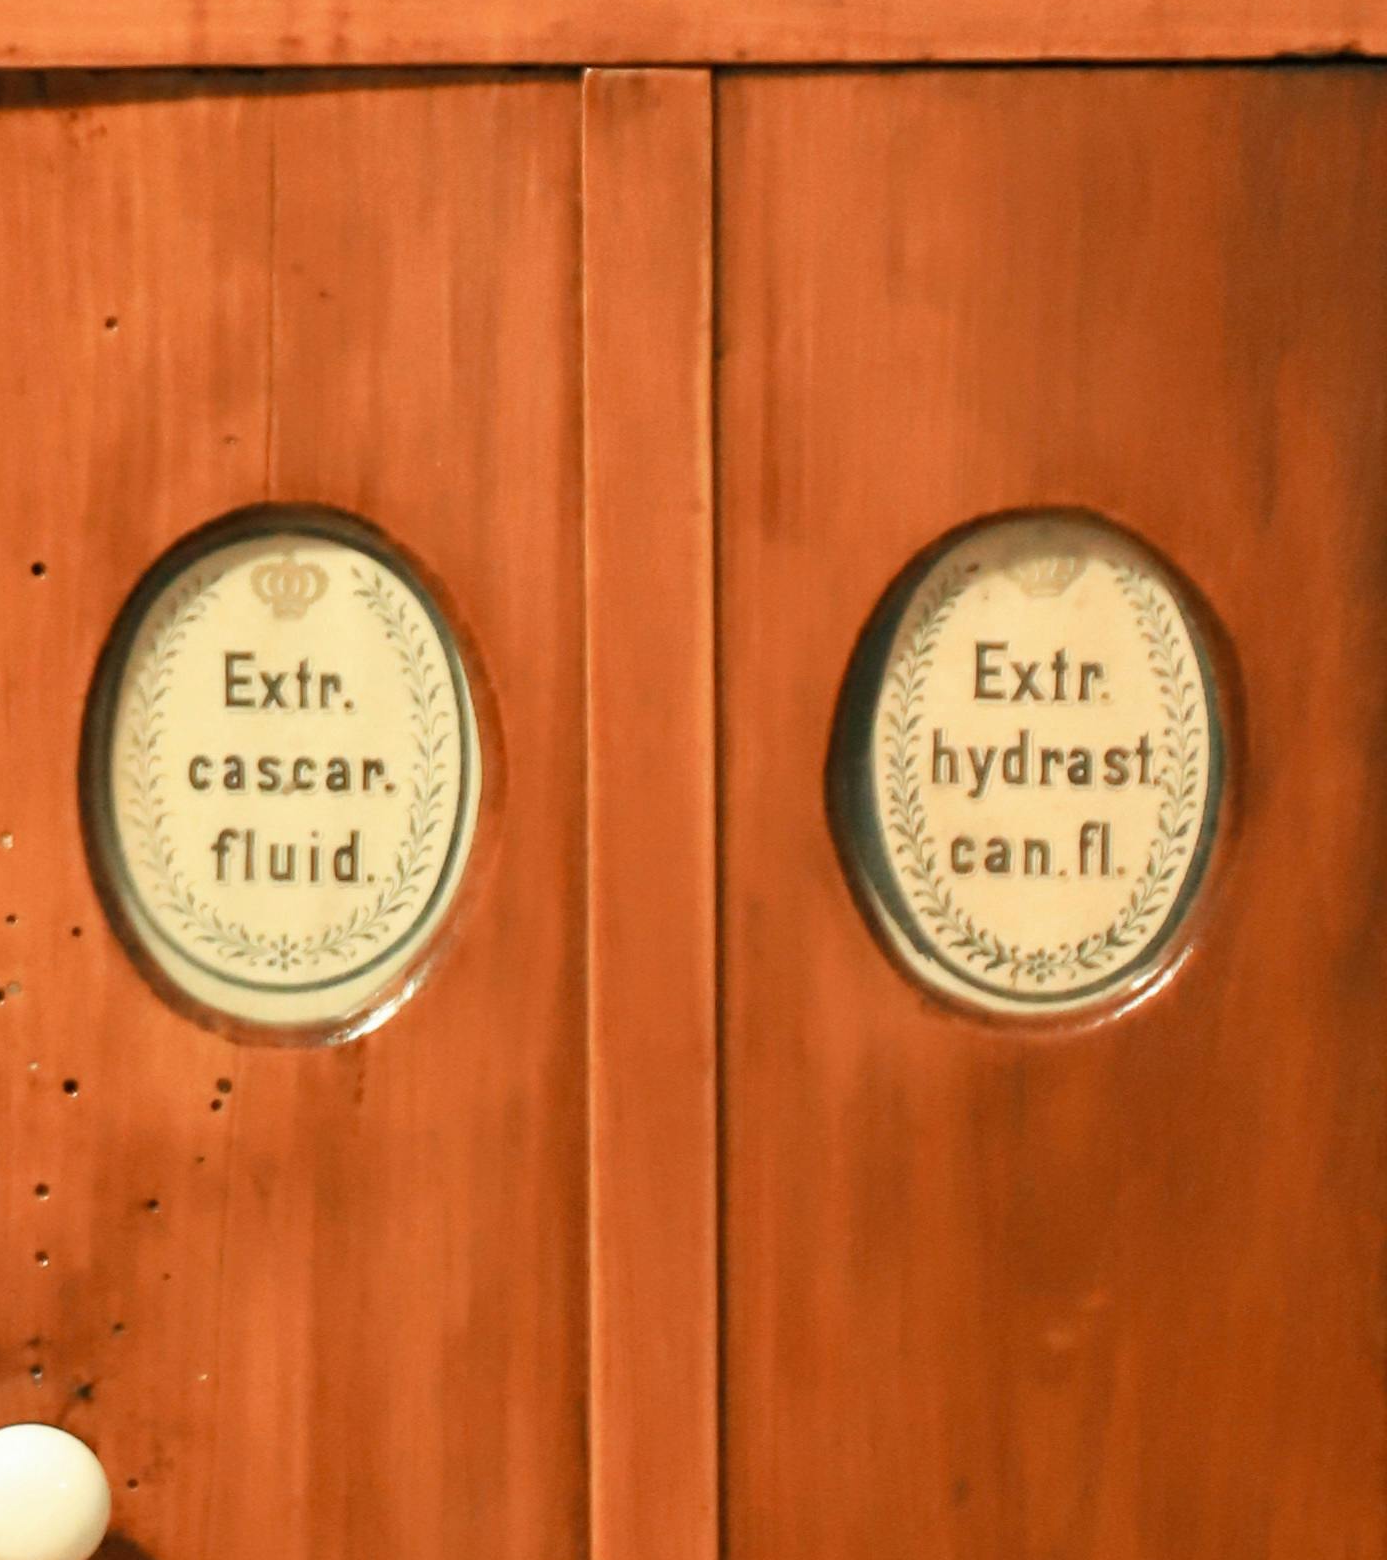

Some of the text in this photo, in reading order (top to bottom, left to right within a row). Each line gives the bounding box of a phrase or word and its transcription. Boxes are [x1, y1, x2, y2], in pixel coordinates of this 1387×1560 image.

[224, 651, 354, 711] Extr.
[974, 641, 1110, 702] Extr.
[189, 754, 394, 793] cascar.
[931, 728, 1162, 798] hydrast.
[210, 829, 375, 882] fluid.
